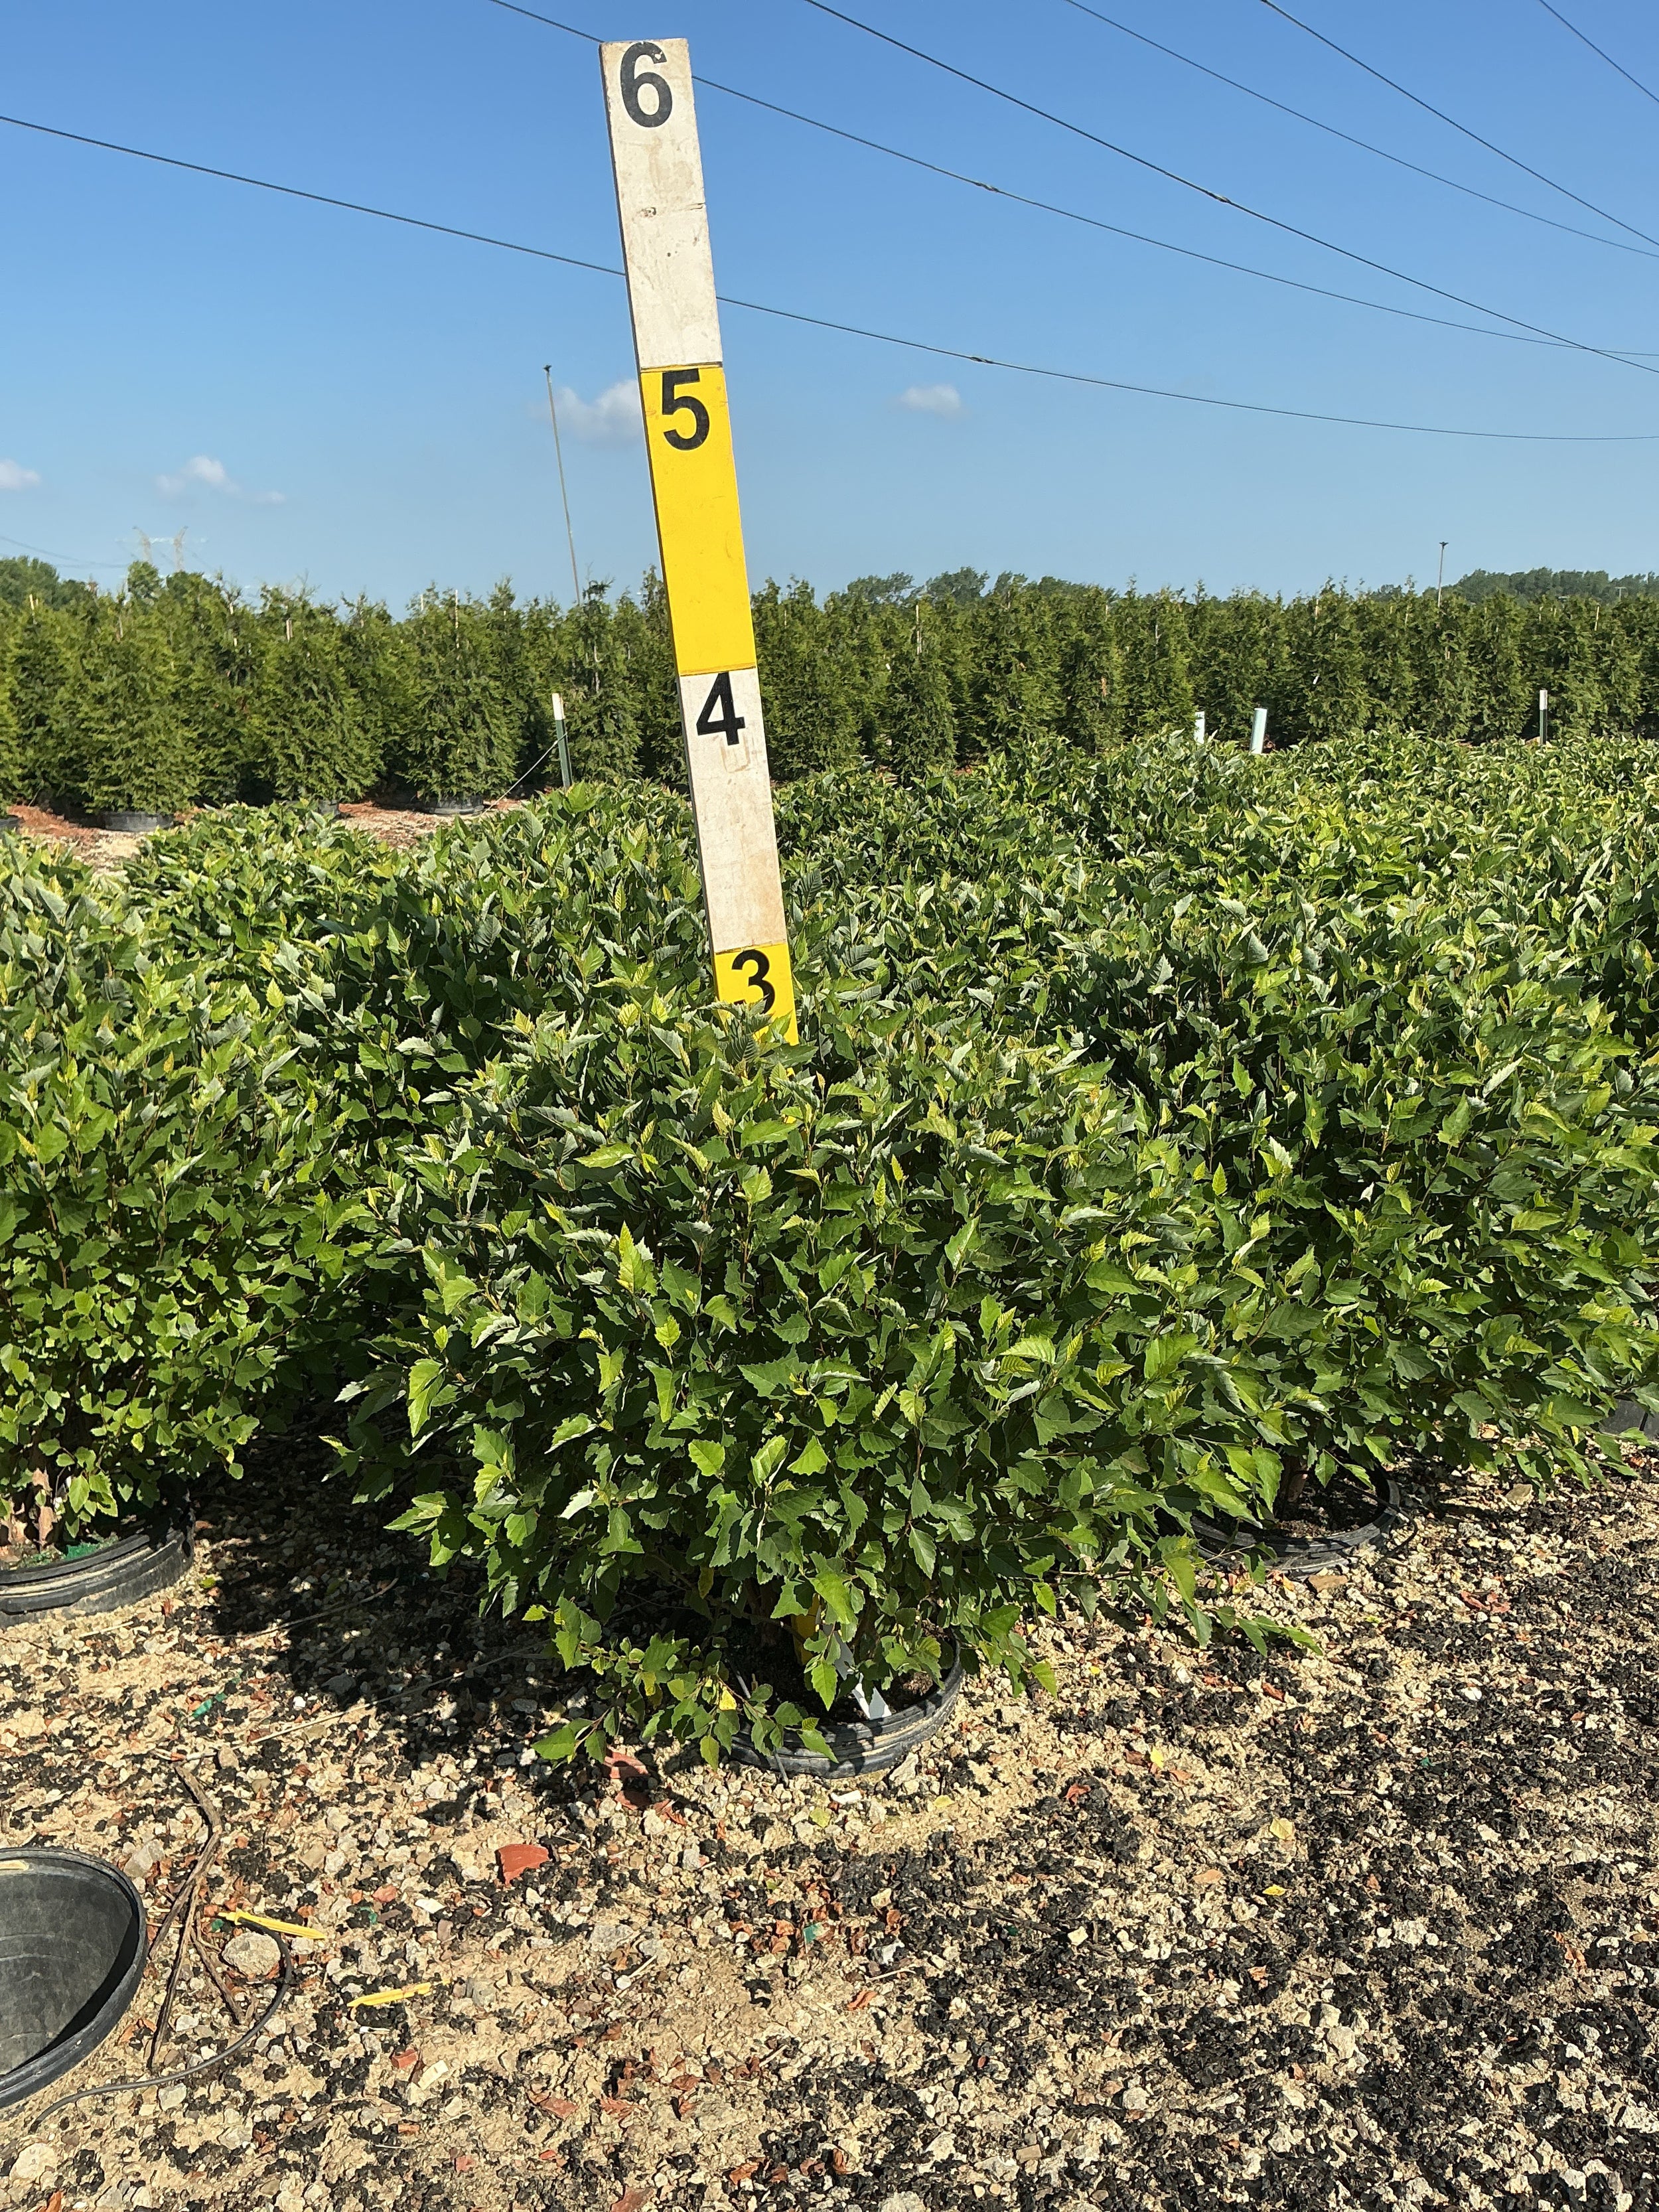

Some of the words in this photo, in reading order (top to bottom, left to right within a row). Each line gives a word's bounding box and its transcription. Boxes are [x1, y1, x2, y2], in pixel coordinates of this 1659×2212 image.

[620, 41, 672, 127] 6
[662, 368, 709, 451] 5
[696, 671, 745, 745] 4
[731, 950, 775, 1014] 3
